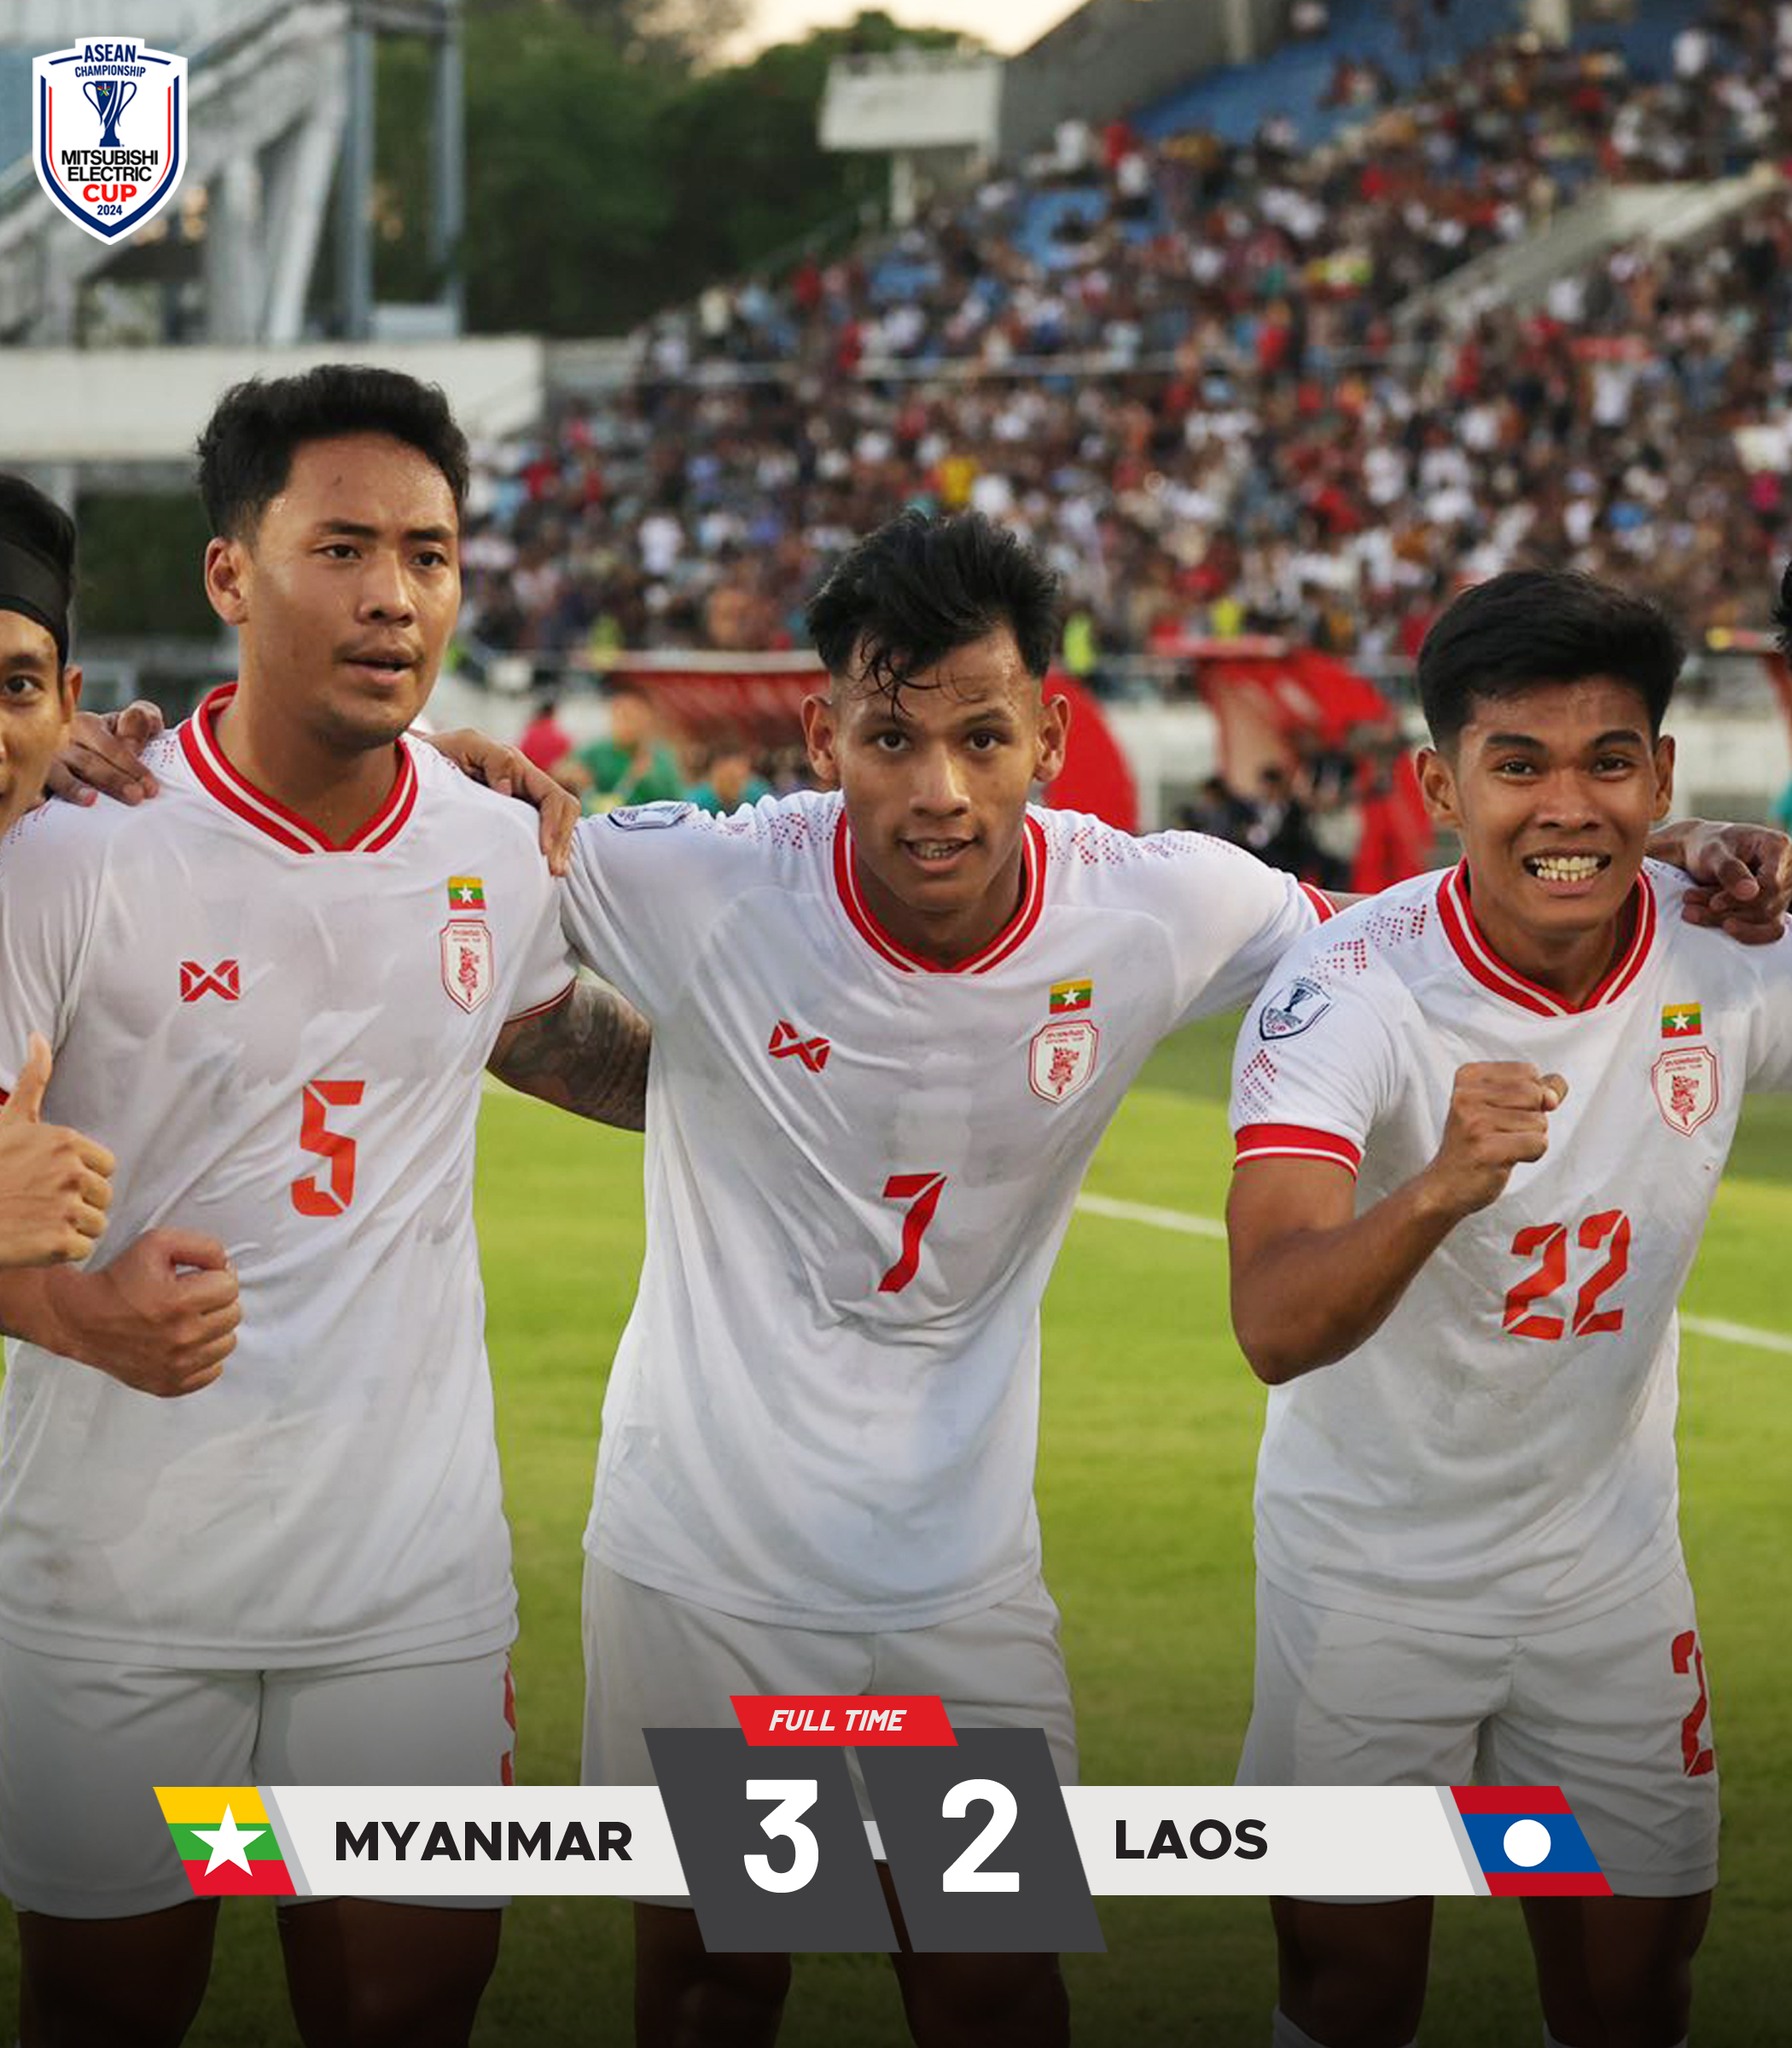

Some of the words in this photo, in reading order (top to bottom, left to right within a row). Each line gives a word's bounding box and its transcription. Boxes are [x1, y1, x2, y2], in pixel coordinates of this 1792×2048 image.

[292, 1079, 364, 1218] 5
[880, 1172, 945, 1292] 7
[1503, 1210, 1631, 1341] 22
